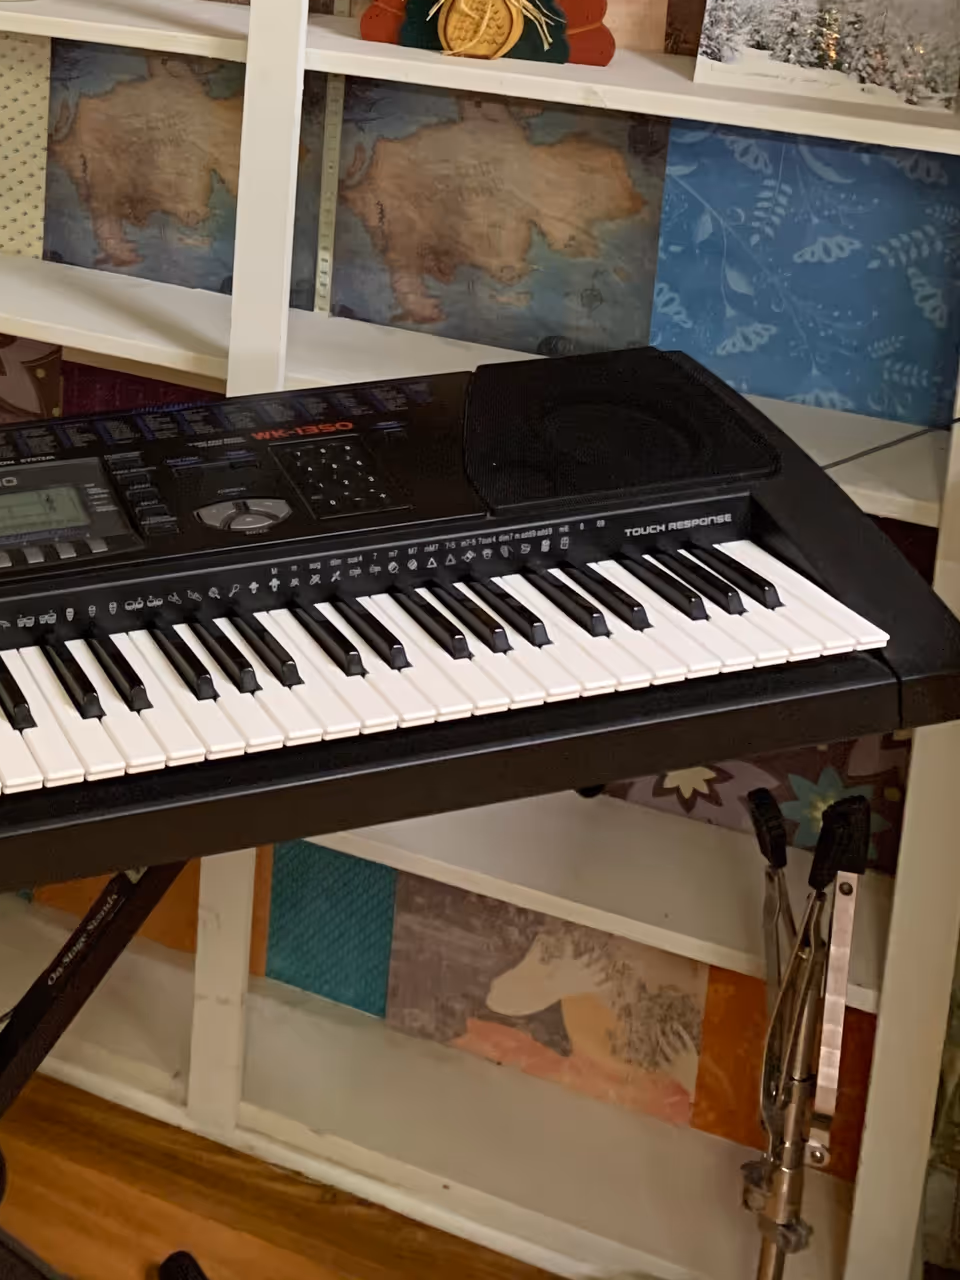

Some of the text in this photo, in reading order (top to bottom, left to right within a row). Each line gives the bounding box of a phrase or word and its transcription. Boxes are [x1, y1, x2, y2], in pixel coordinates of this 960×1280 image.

[251, 422, 353, 440] WK-1350
[624, 513, 732, 538] TOUCH RESPONSE
[85, 893, 119, 932] Stands
